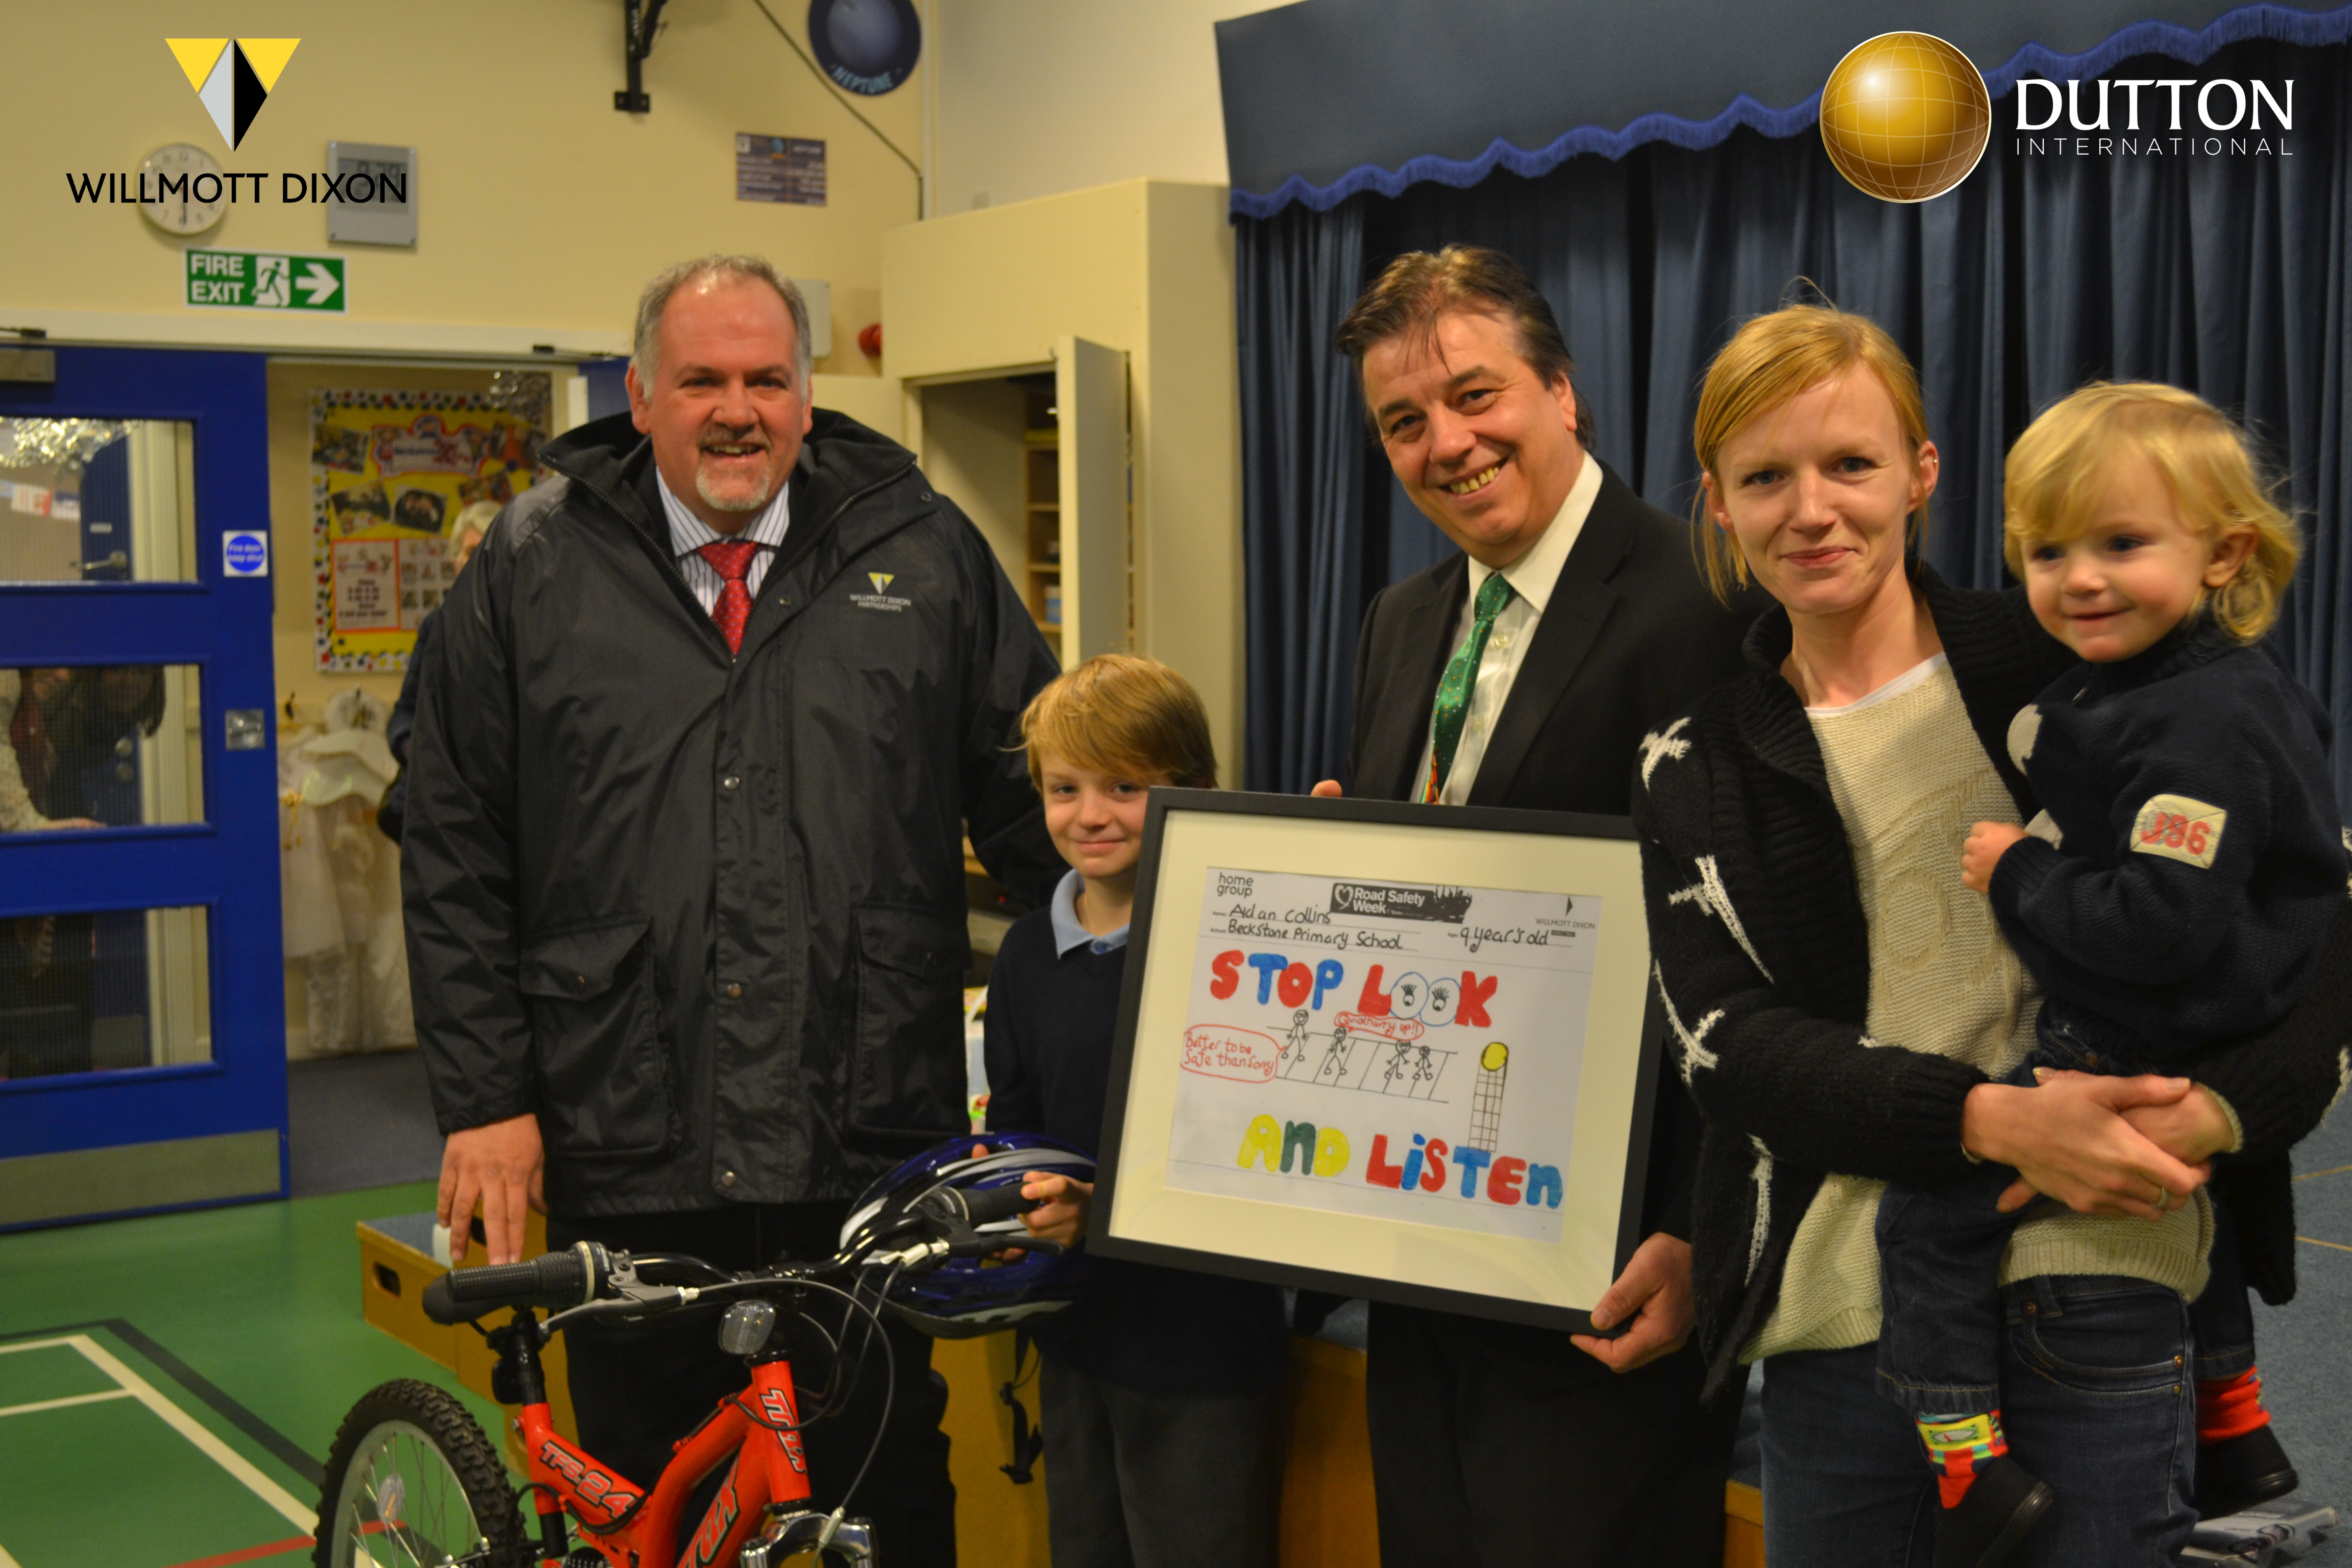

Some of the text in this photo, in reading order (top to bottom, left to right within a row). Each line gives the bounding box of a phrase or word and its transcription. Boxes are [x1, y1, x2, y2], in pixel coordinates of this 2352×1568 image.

[832, 66, 894, 94] NEPTUNE
[191, 254, 244, 277] FIRE
[191, 280, 245, 303] EXIT
[849, 594, 912, 606] WILLMOTT DIXON
[1218, 872, 1254, 887] home
[1217, 884, 1253, 898] group
[1354, 887, 1425, 908] Road Safety
[1353, 899, 1387, 914] Week
[1535, 918, 1571, 927] WILLMOTT
[1293, 927, 1349, 950] Primary
[1356, 930, 1403, 949] School
[1210, 949, 1344, 1010] STOP
[1357, 964, 1498, 1027] LOOK
[1186, 1031, 1221, 1050] Better
